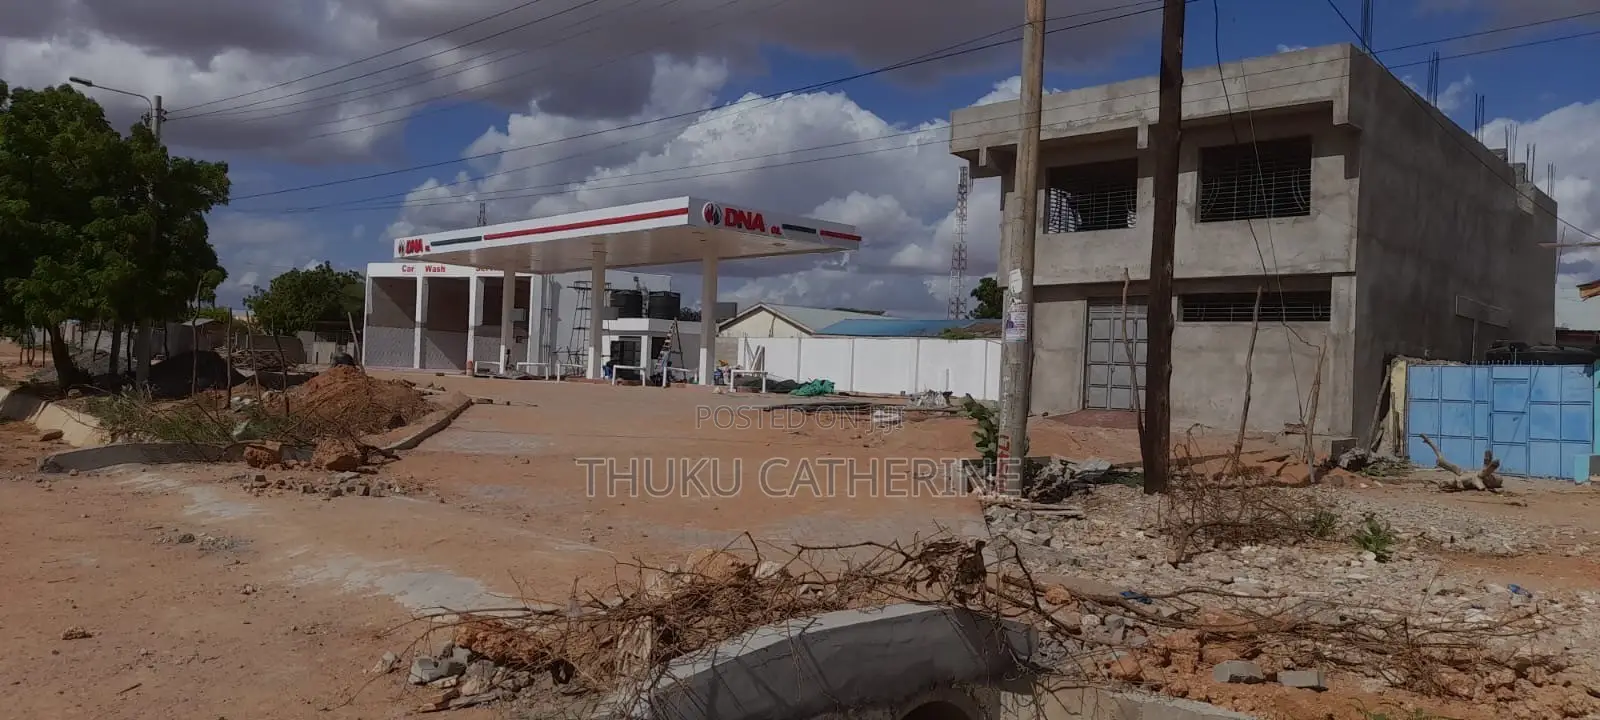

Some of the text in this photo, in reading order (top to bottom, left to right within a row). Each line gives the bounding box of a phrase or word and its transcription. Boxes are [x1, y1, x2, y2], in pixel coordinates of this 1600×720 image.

[724, 207, 765, 232] DNA
[402, 264, 446, 273] Car Wash
